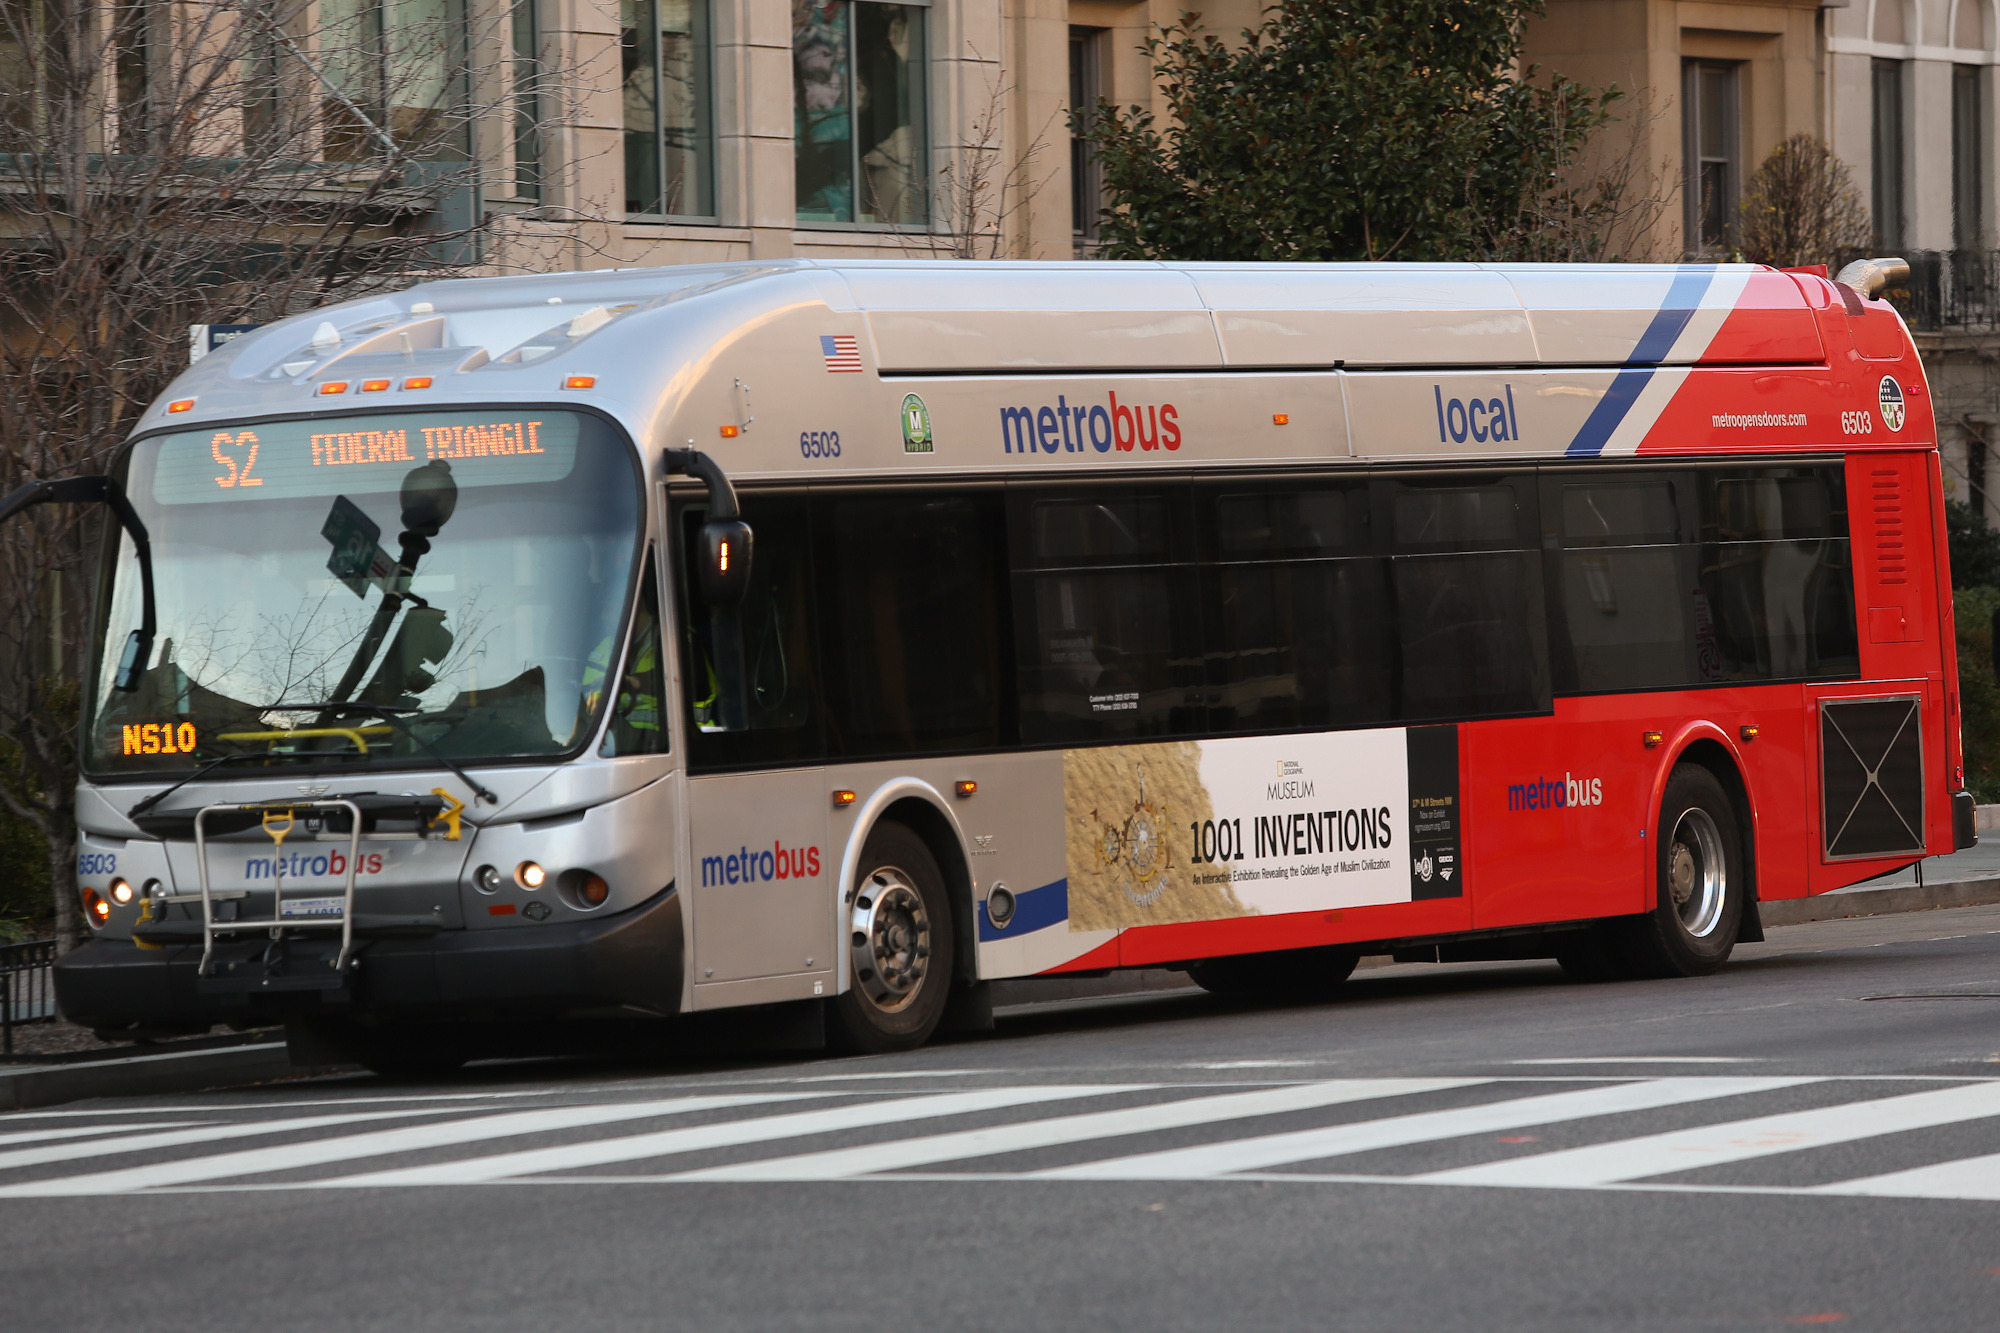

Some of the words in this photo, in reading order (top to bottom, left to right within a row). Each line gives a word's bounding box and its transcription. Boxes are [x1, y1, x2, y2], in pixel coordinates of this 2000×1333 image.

[1000, 391, 1182, 454] metrobus
[1434, 384, 1519, 444] local
[1712, 411, 1808, 431] metroopensdoors.com
[1841, 411, 1873, 435] 6503
[211, 431, 263, 488] S2
[311, 429, 415, 466] FEDERAL
[420, 421, 545, 460] TRIANGLE
[800, 432, 842, 459] 6503
[122, 722, 197, 755] NS10
[1267, 780, 1315, 801] MUSEUM
[1508, 772, 1603, 811] metrobus
[1190, 817, 1245, 865] 1001
[1254, 806, 1392, 859] INVENTIONS
[79, 853, 116, 875] 6503
[702, 840, 821, 887] metrobus
[1193, 873, 1201, 885] An
[1202, 872, 1232, 885] Interactive
[1233, 869, 1261, 882] Exhibition
[1262, 867, 1289, 880] Revealing
[1289, 866, 1299, 877] the
[1300, 863, 1320, 876] Golden
[1321, 862, 1333, 877] Age
[1334, 862, 1340, 874] of
[1340, 860, 1360, 873] Muslim
[1361, 858, 1391, 872] Civilization
